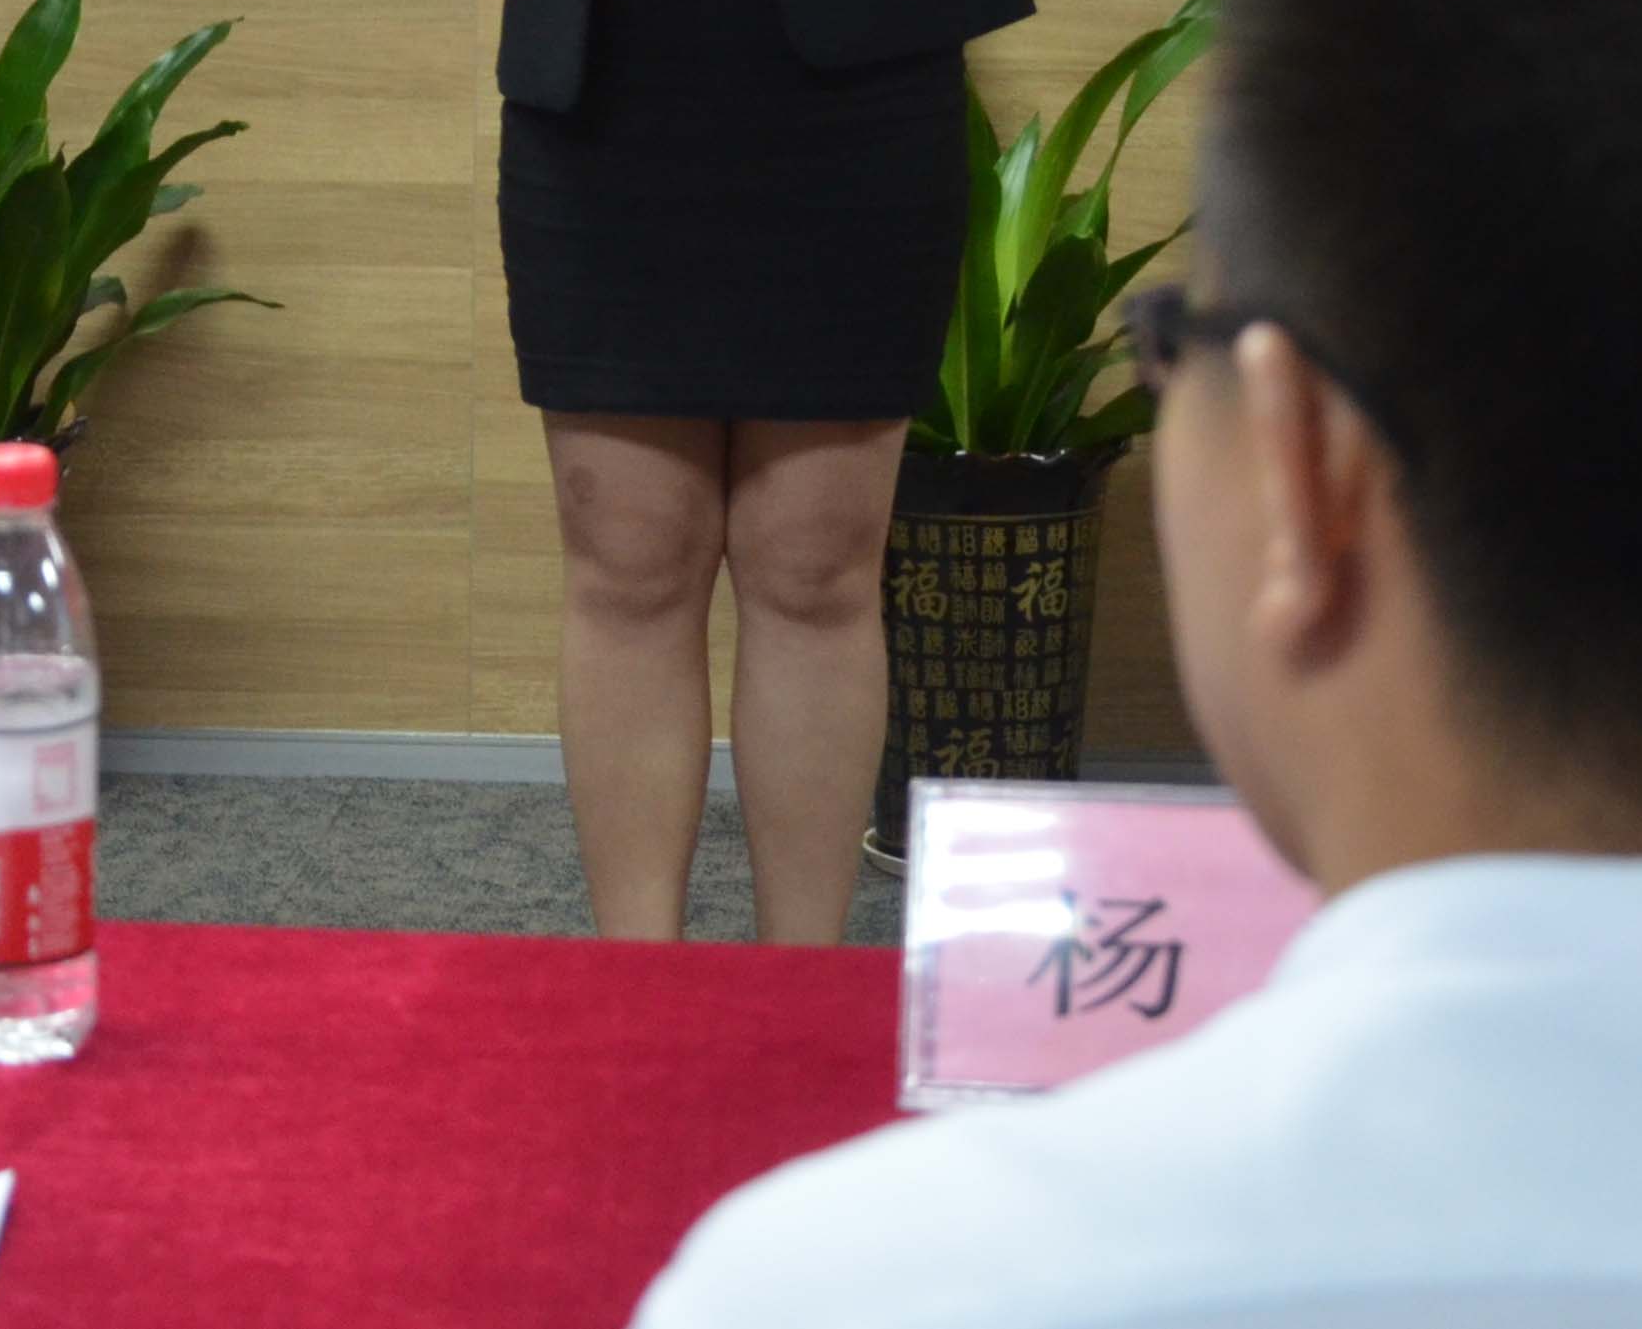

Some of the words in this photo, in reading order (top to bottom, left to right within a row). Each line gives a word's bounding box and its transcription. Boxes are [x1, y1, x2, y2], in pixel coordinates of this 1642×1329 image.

[890, 559, 948, 622] 福
[1011, 557, 1068, 623] 福
[1027, 888, 1186, 1020] 杨
